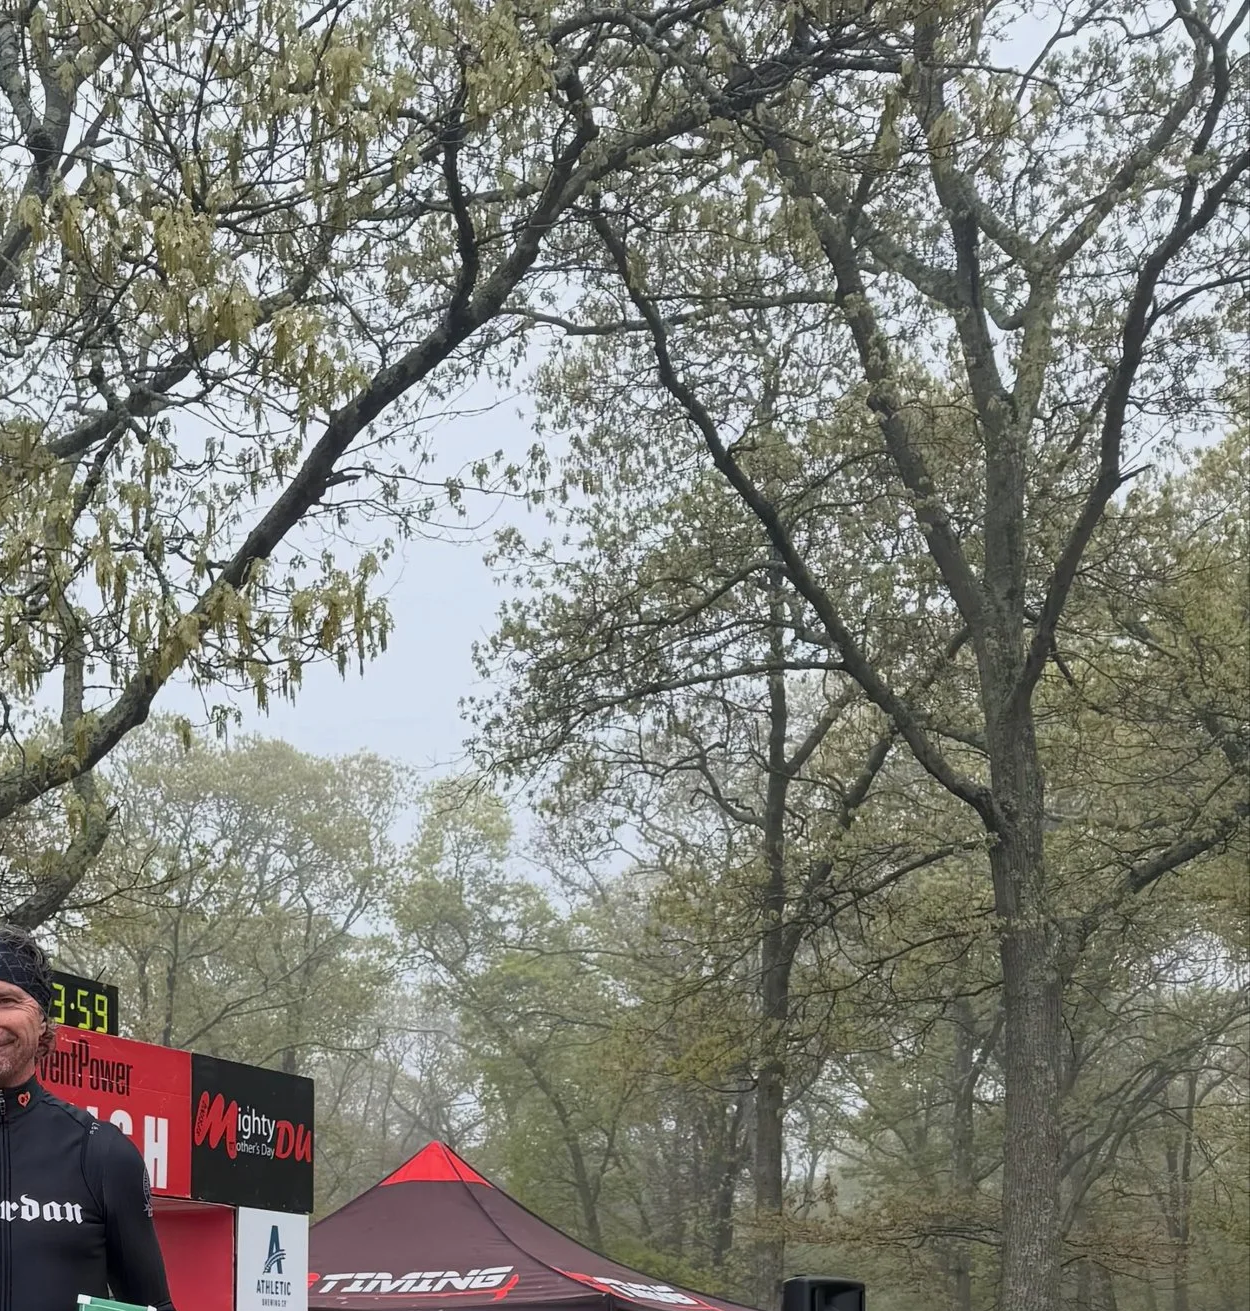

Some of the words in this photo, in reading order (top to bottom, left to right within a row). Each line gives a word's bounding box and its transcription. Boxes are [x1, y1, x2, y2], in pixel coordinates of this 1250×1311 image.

[39, 1039, 133, 1097] ventPower
[256, 1279, 291, 1296] ATHLETIC
[319, 1266, 513, 1293] TIMING
